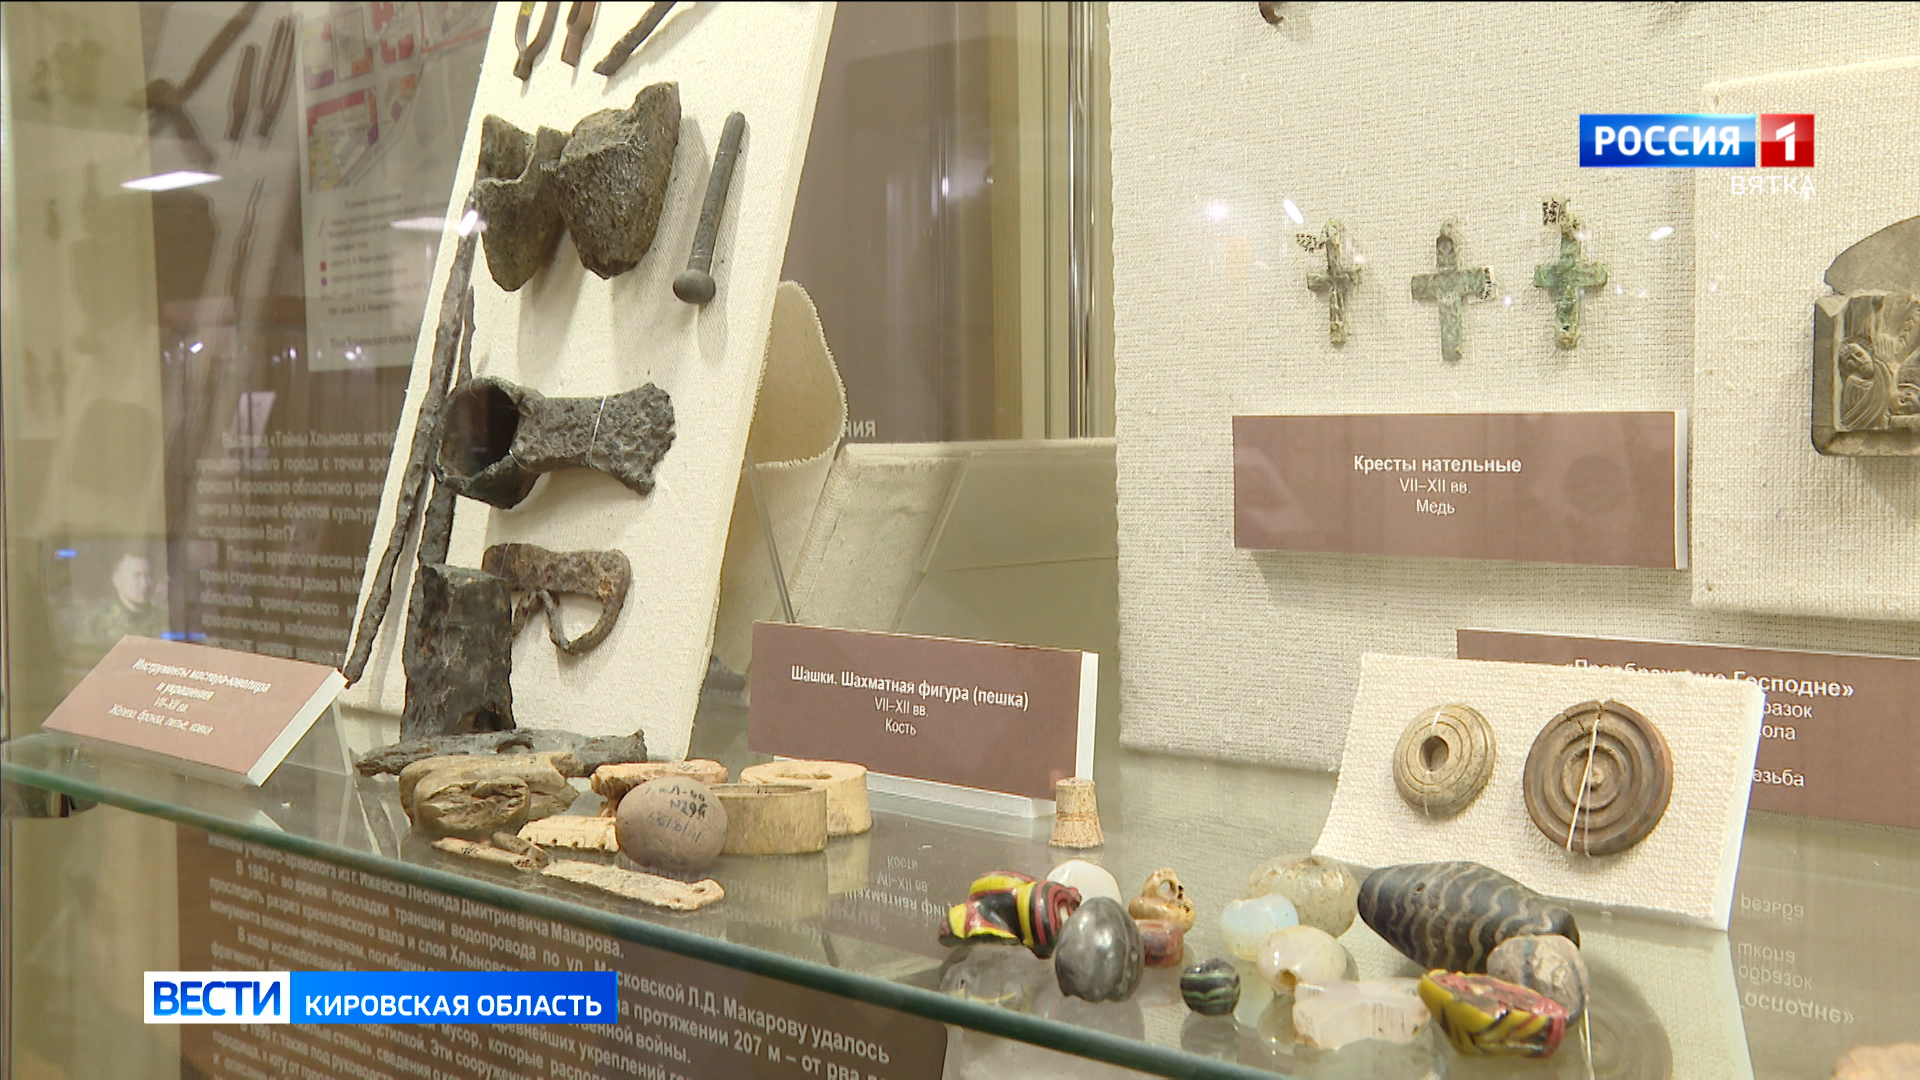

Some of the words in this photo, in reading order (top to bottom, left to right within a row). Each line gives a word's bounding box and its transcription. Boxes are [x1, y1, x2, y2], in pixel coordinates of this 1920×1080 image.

[364, 431, 396, 449] истор
[283, 458, 319, 473] города
[333, 458, 364, 472] точки
[368, 458, 390, 474] зре
[1354, 455, 1416, 476] Кресты
[1421, 458, 1522, 473] нательные
[235, 479, 290, 496] Кировского
[292, 478, 350, 496] областного
[281, 502, 330, 520] объектов
[1416, 498, 1456, 516] Медь
[230, 572, 302, 590] строительства
[304, 576, 337, 592] домов
[791, 665, 837, 685] Шашки.
[841, 671, 915, 694] Шахматная
[918, 680, 970, 703] фигура
[973, 686, 1029, 712] (пешка)
[885, 718, 917, 736] Кость
[359, 872, 407, 900] Ижевска
[408, 884, 460, 913] Леонида
[461, 898, 549, 937] Дмитриевича
[551, 922, 625, 958] Макарова.
[236, 858, 244, 876] В
[280, 875, 294, 890] во
[295, 879, 327, 901] время
[331, 889, 390, 918] прокладки
[395, 907, 446, 934] траншеи
[451, 923, 537, 962] водопровода
[543, 949, 561, 968] по
[566, 956, 584, 971] ул
[594, 959, 684, 1004] Мсковской
[688, 985, 721, 1018] Л.Д.
[723, 996, 808, 1044] Макарову
[811, 1025, 890, 1064] удалось
[238, 925, 246, 943] В
[578, 1041, 667, 1080] укреплений
[302, 905, 376, 938] кремлевского
[378, 924, 405, 947] вала
[408, 934, 415, 950] и
[418, 938, 447, 960] слоя
[633, 1004, 729, 1048] протяжении
[733, 1029, 762, 1056] 207
[767, 1044, 781, 1063] м
[801, 1055, 821, 1076] от
[430, 1037, 453, 1062] Эти
[441, 1023, 483, 1051] мусор,
[487, 1037, 544, 1070] которые
[636, 1034, 692, 1064] войны.
[310, 1045, 331, 1067] под
[332, 1054, 394, 1080] руководст
[376, 1047, 431, 1076] сведения
